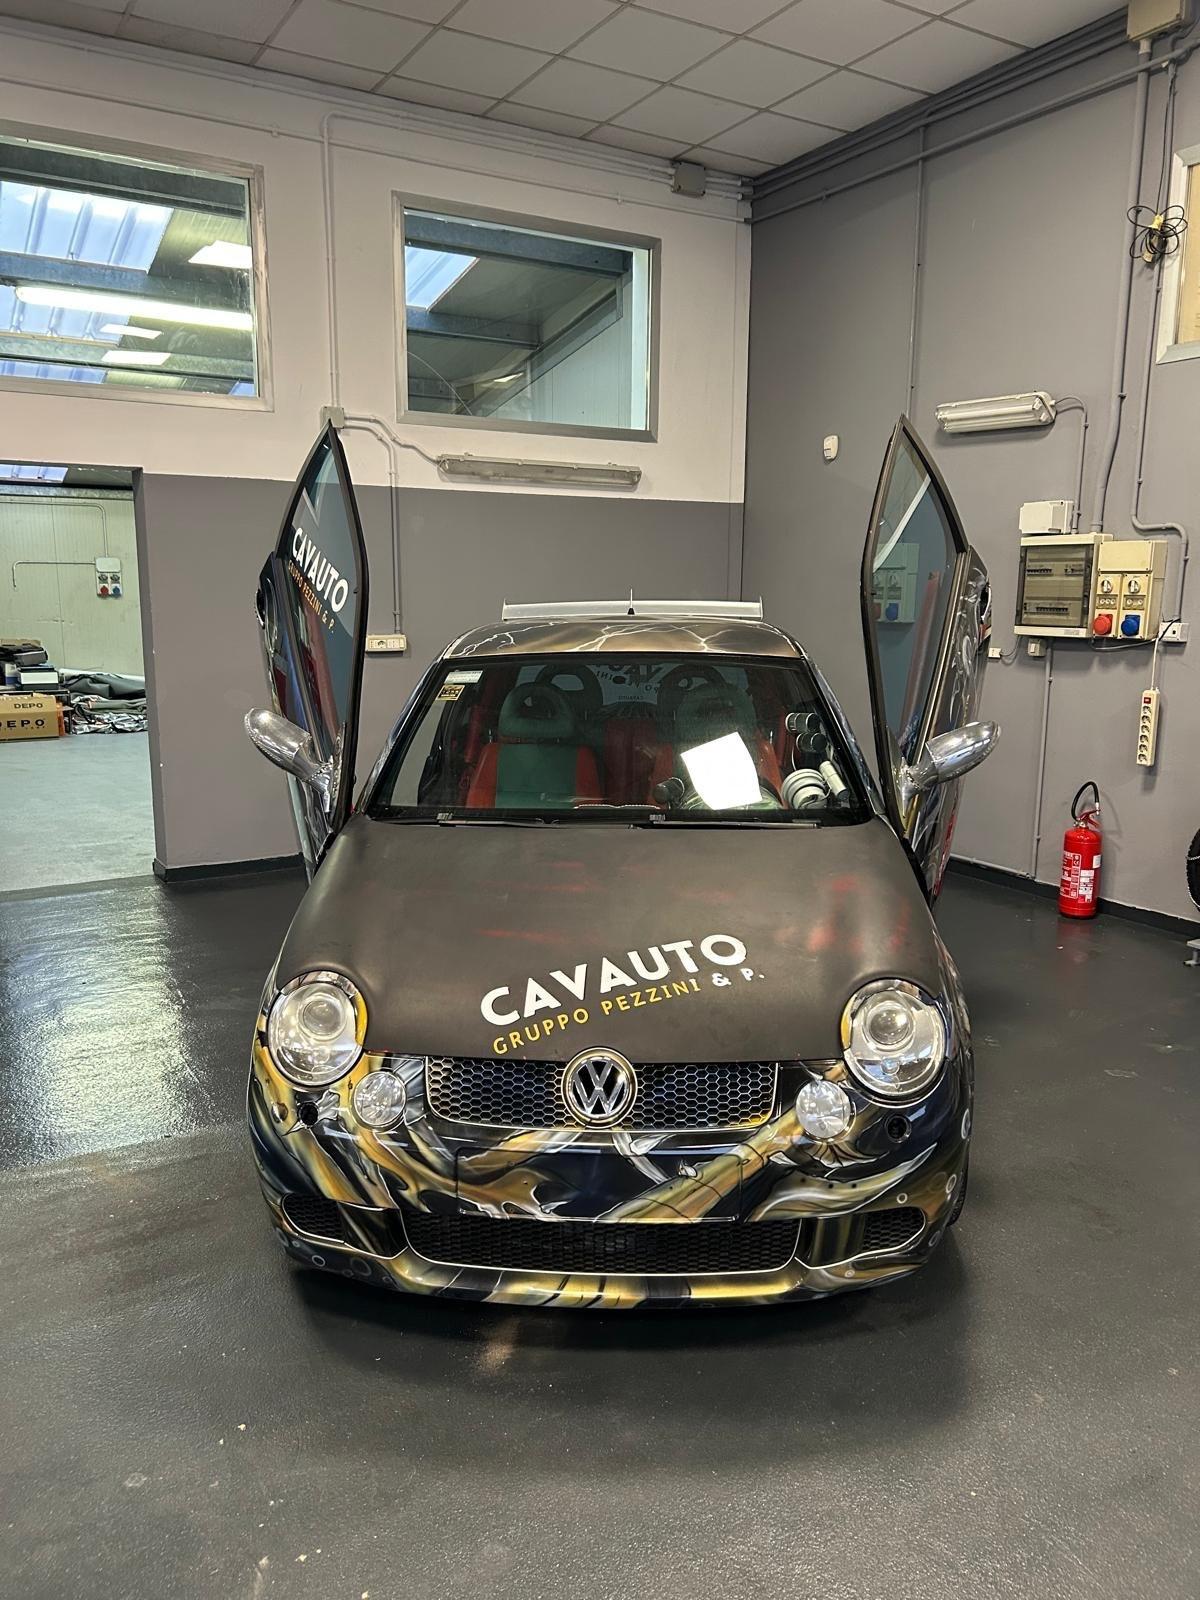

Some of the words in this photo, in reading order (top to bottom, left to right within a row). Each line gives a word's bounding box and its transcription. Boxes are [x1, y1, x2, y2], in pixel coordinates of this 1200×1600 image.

[288, 559, 303, 588] GRUPPO
[302, 582, 323, 616] PEZZINI
[292, 527, 349, 613] CAVAUTO
[0, 719, 45, 728] EPO
[480, 934, 747, 1026] CAVAUTO
[493, 1008, 589, 1055] GRUPPO
[601, 978, 701, 1016] PEZZINI
[711, 972, 732, 987] &
[569, 1056, 629, 1117] VW
